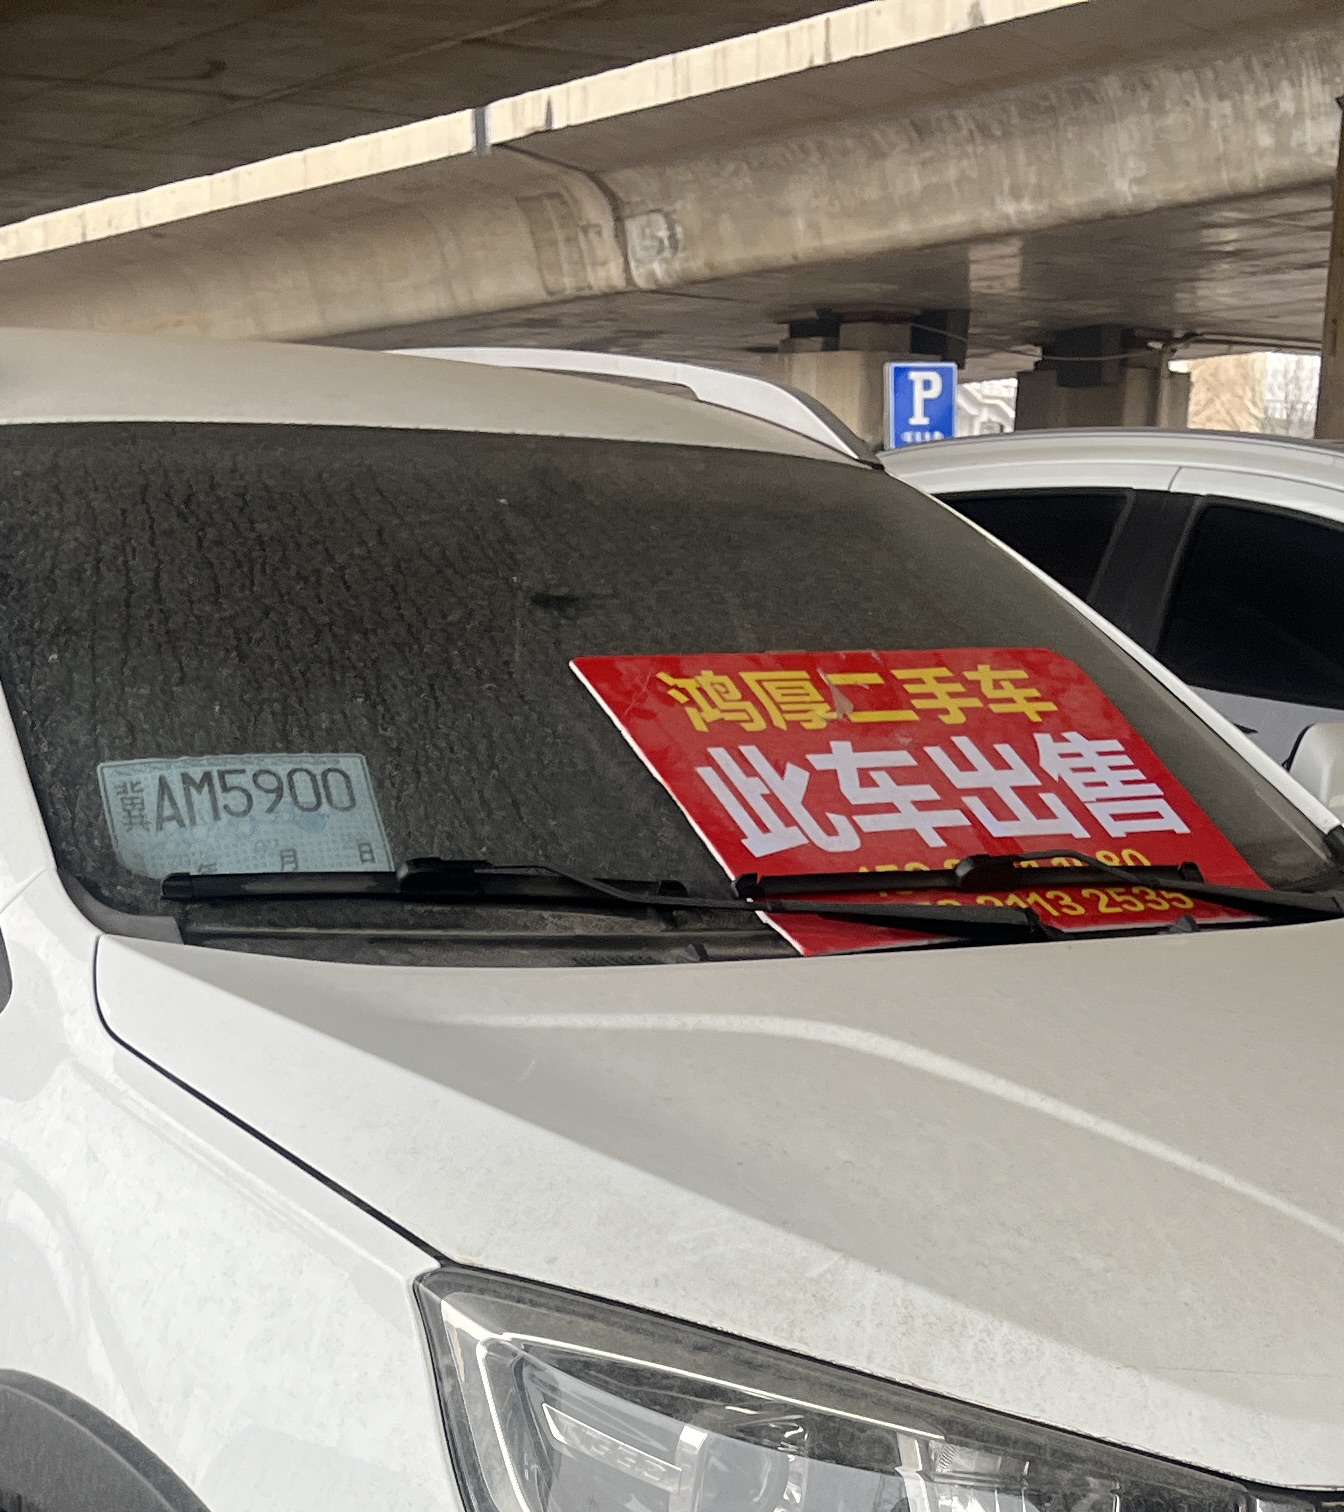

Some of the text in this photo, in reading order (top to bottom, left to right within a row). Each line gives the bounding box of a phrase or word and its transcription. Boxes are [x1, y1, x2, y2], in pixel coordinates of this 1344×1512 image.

[908, 371, 943, 426] P
[656, 664, 1058, 732] 鸿厚二手车
[115, 767, 355, 832] 冀AM5900
[696, 730, 1191, 858] 此车出售
[1081, 885, 1194, 914] 2535
